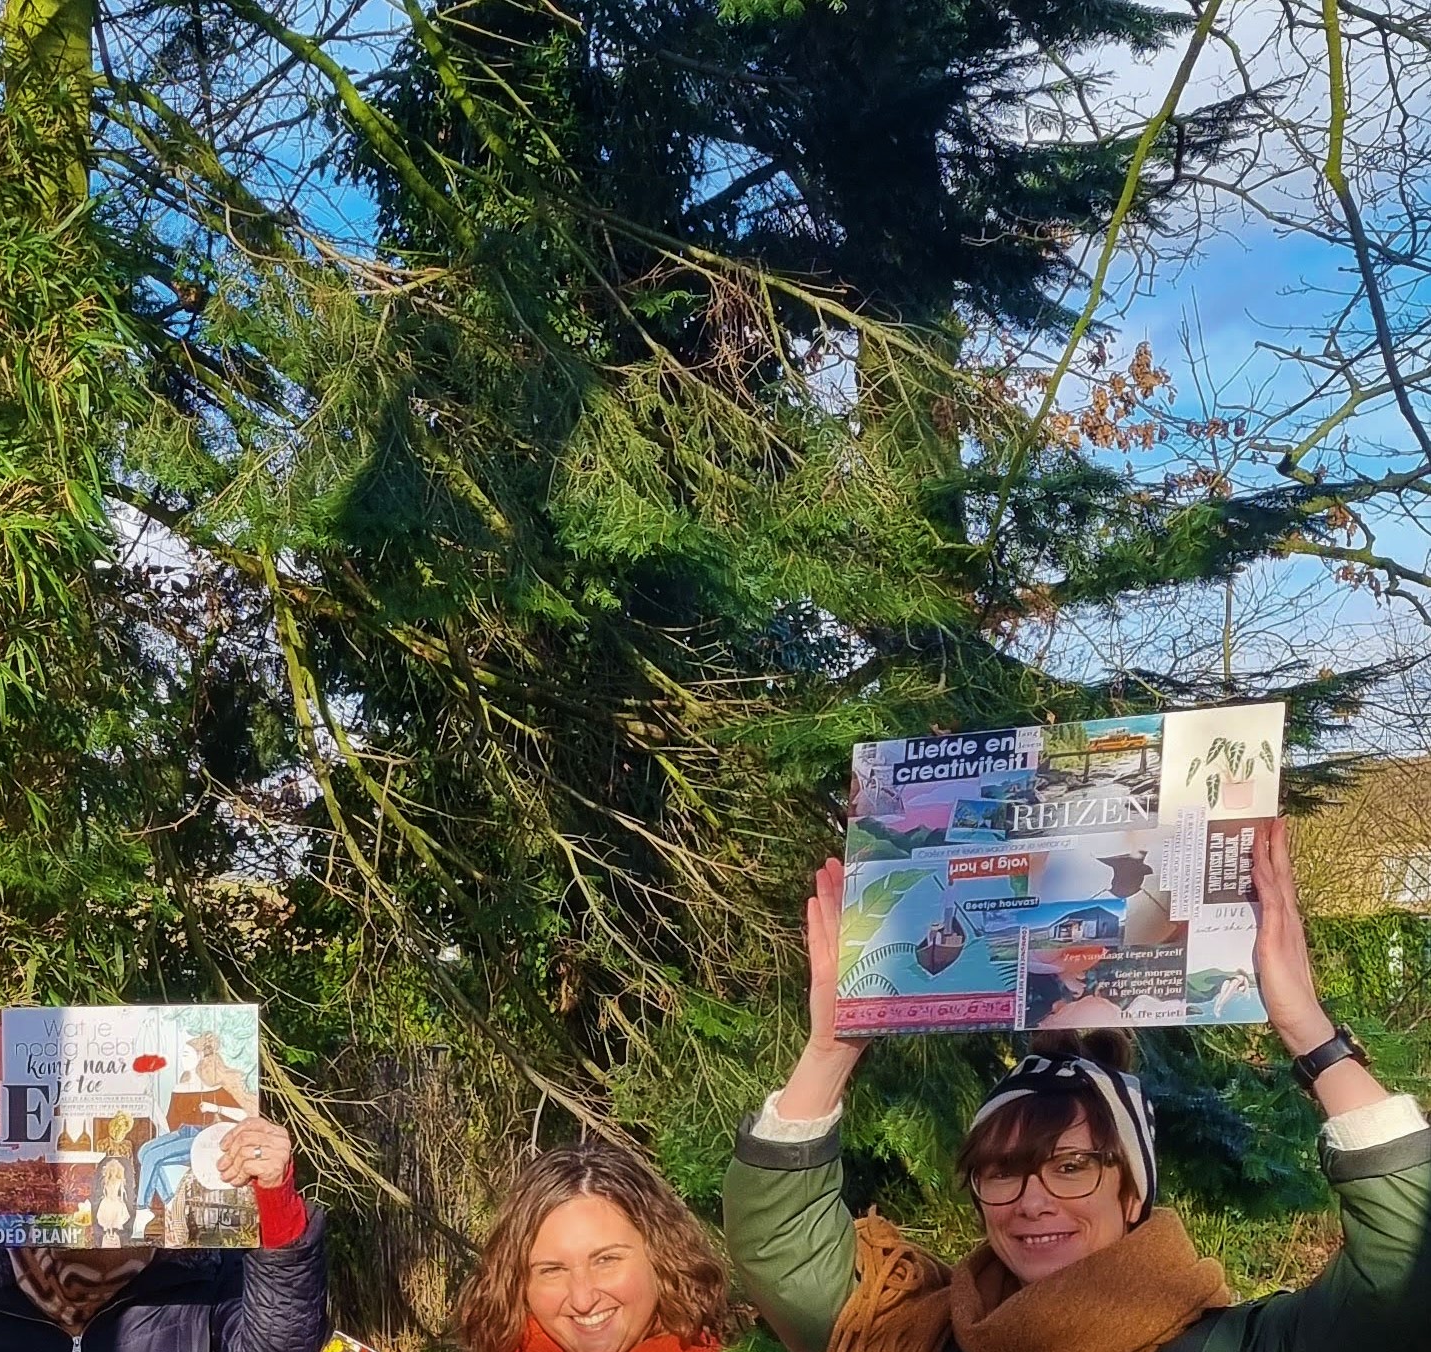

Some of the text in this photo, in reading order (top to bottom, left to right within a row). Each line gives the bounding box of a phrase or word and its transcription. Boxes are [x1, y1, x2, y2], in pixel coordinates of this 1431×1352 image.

[907, 736, 1016, 760] Liefde en
[896, 753, 1024, 783] creativiteit
[1011, 796, 1151, 832] REIZEN
[949, 856, 1029, 875] volg je hart
[965, 897, 1039, 911] Beetje houvast
[1215, 906, 1246, 919] DIVE
[1126, 950, 1153, 959] tegen
[1154, 947, 1184, 959] jezelf
[1131, 977, 1154, 987] goed
[1156, 976, 1183, 986] bezig
[1144, 969, 1183, 978] morgen
[1121, 986, 1151, 997] geloof
[43, 1019, 113, 1041] Wat je
[15, 1038, 78, 1061] nodig
[27, 1054, 127, 1079] komt naar
[53, 1074, 103, 1106] je toe
[2, 1084, 52, 1143] E
